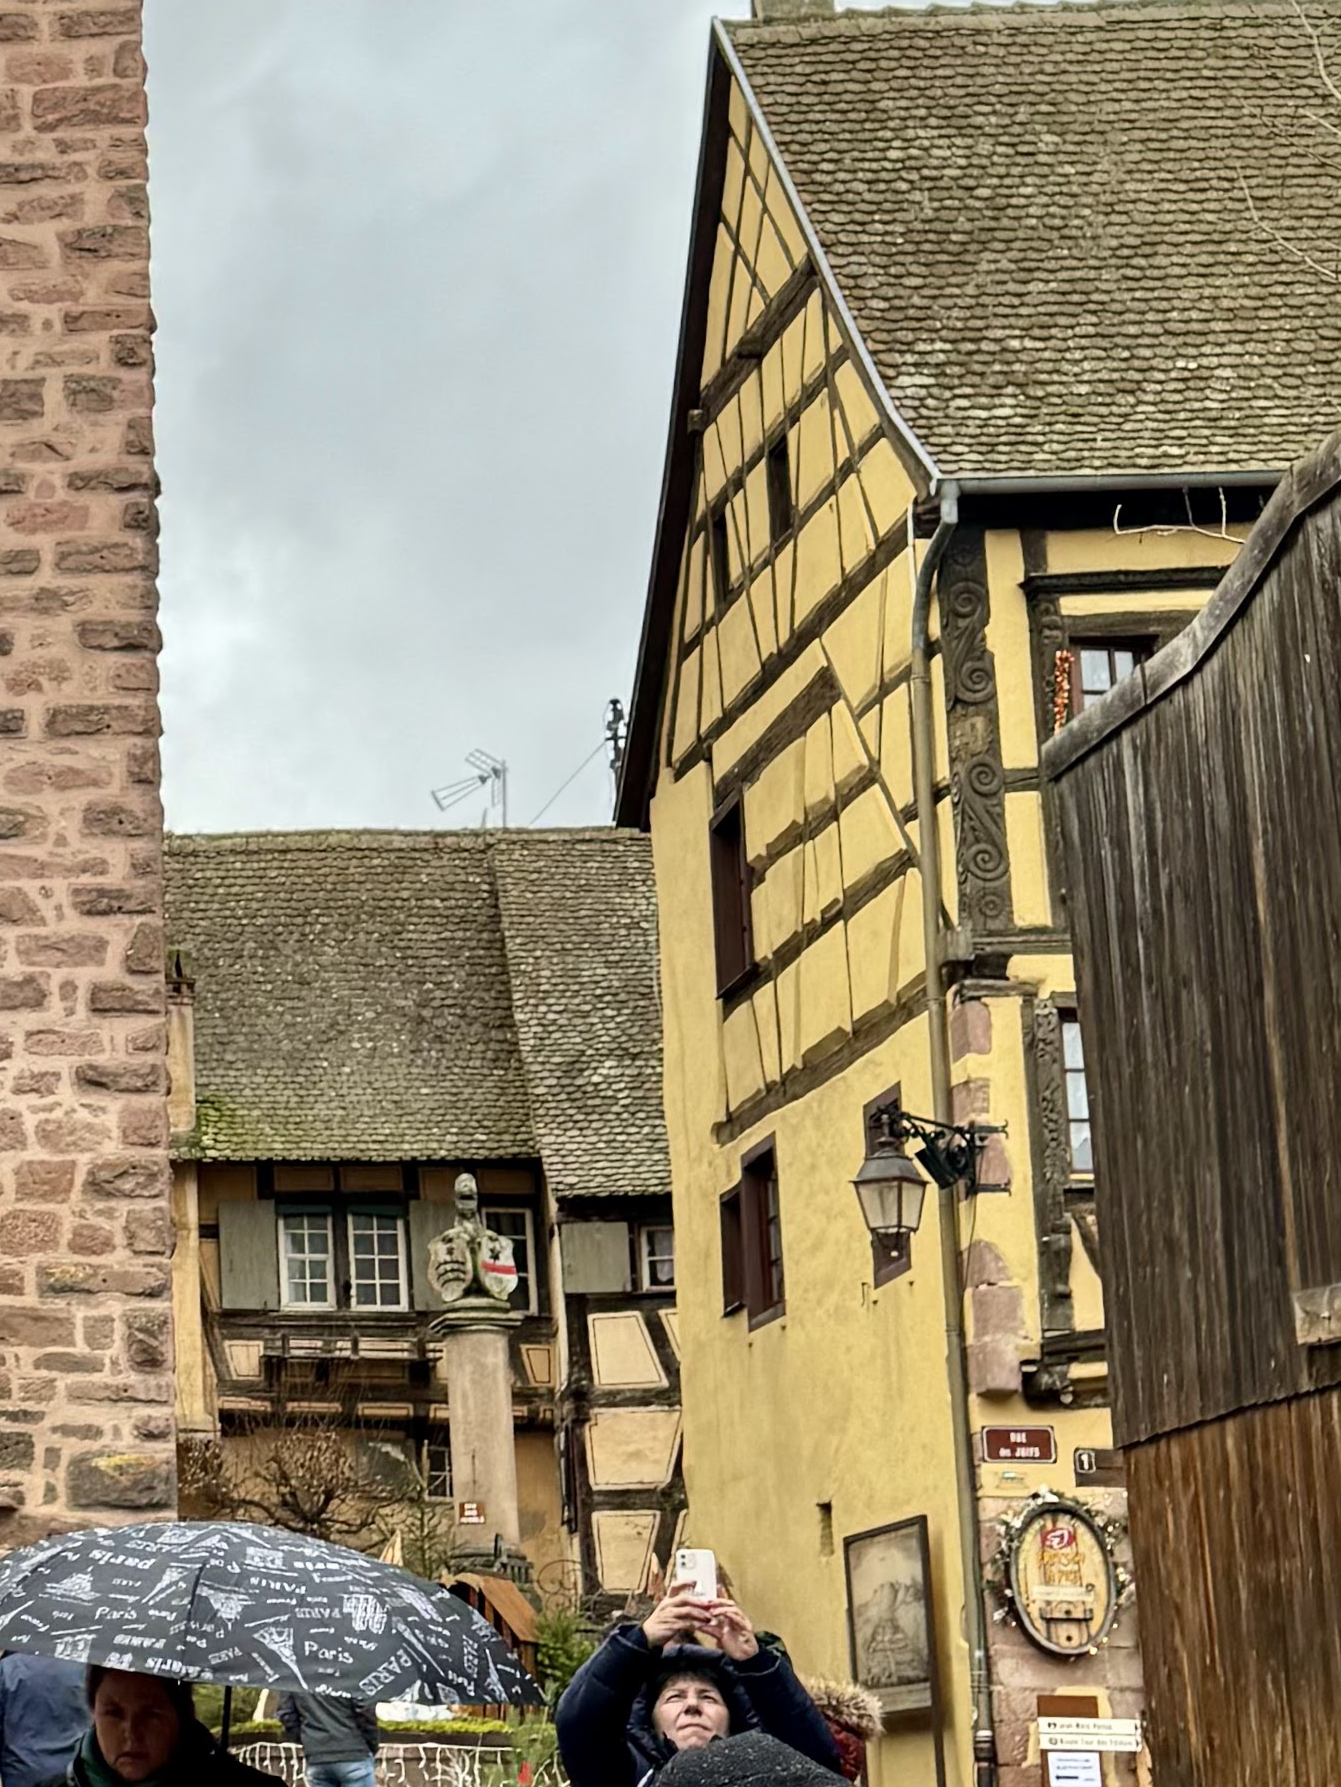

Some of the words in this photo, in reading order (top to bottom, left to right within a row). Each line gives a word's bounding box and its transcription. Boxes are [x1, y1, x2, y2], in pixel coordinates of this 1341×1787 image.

[1080, 1453, 1089, 1470] 1
[304, 1640, 354, 1664] Paris
[359, 1649, 412, 1696] PARIS
